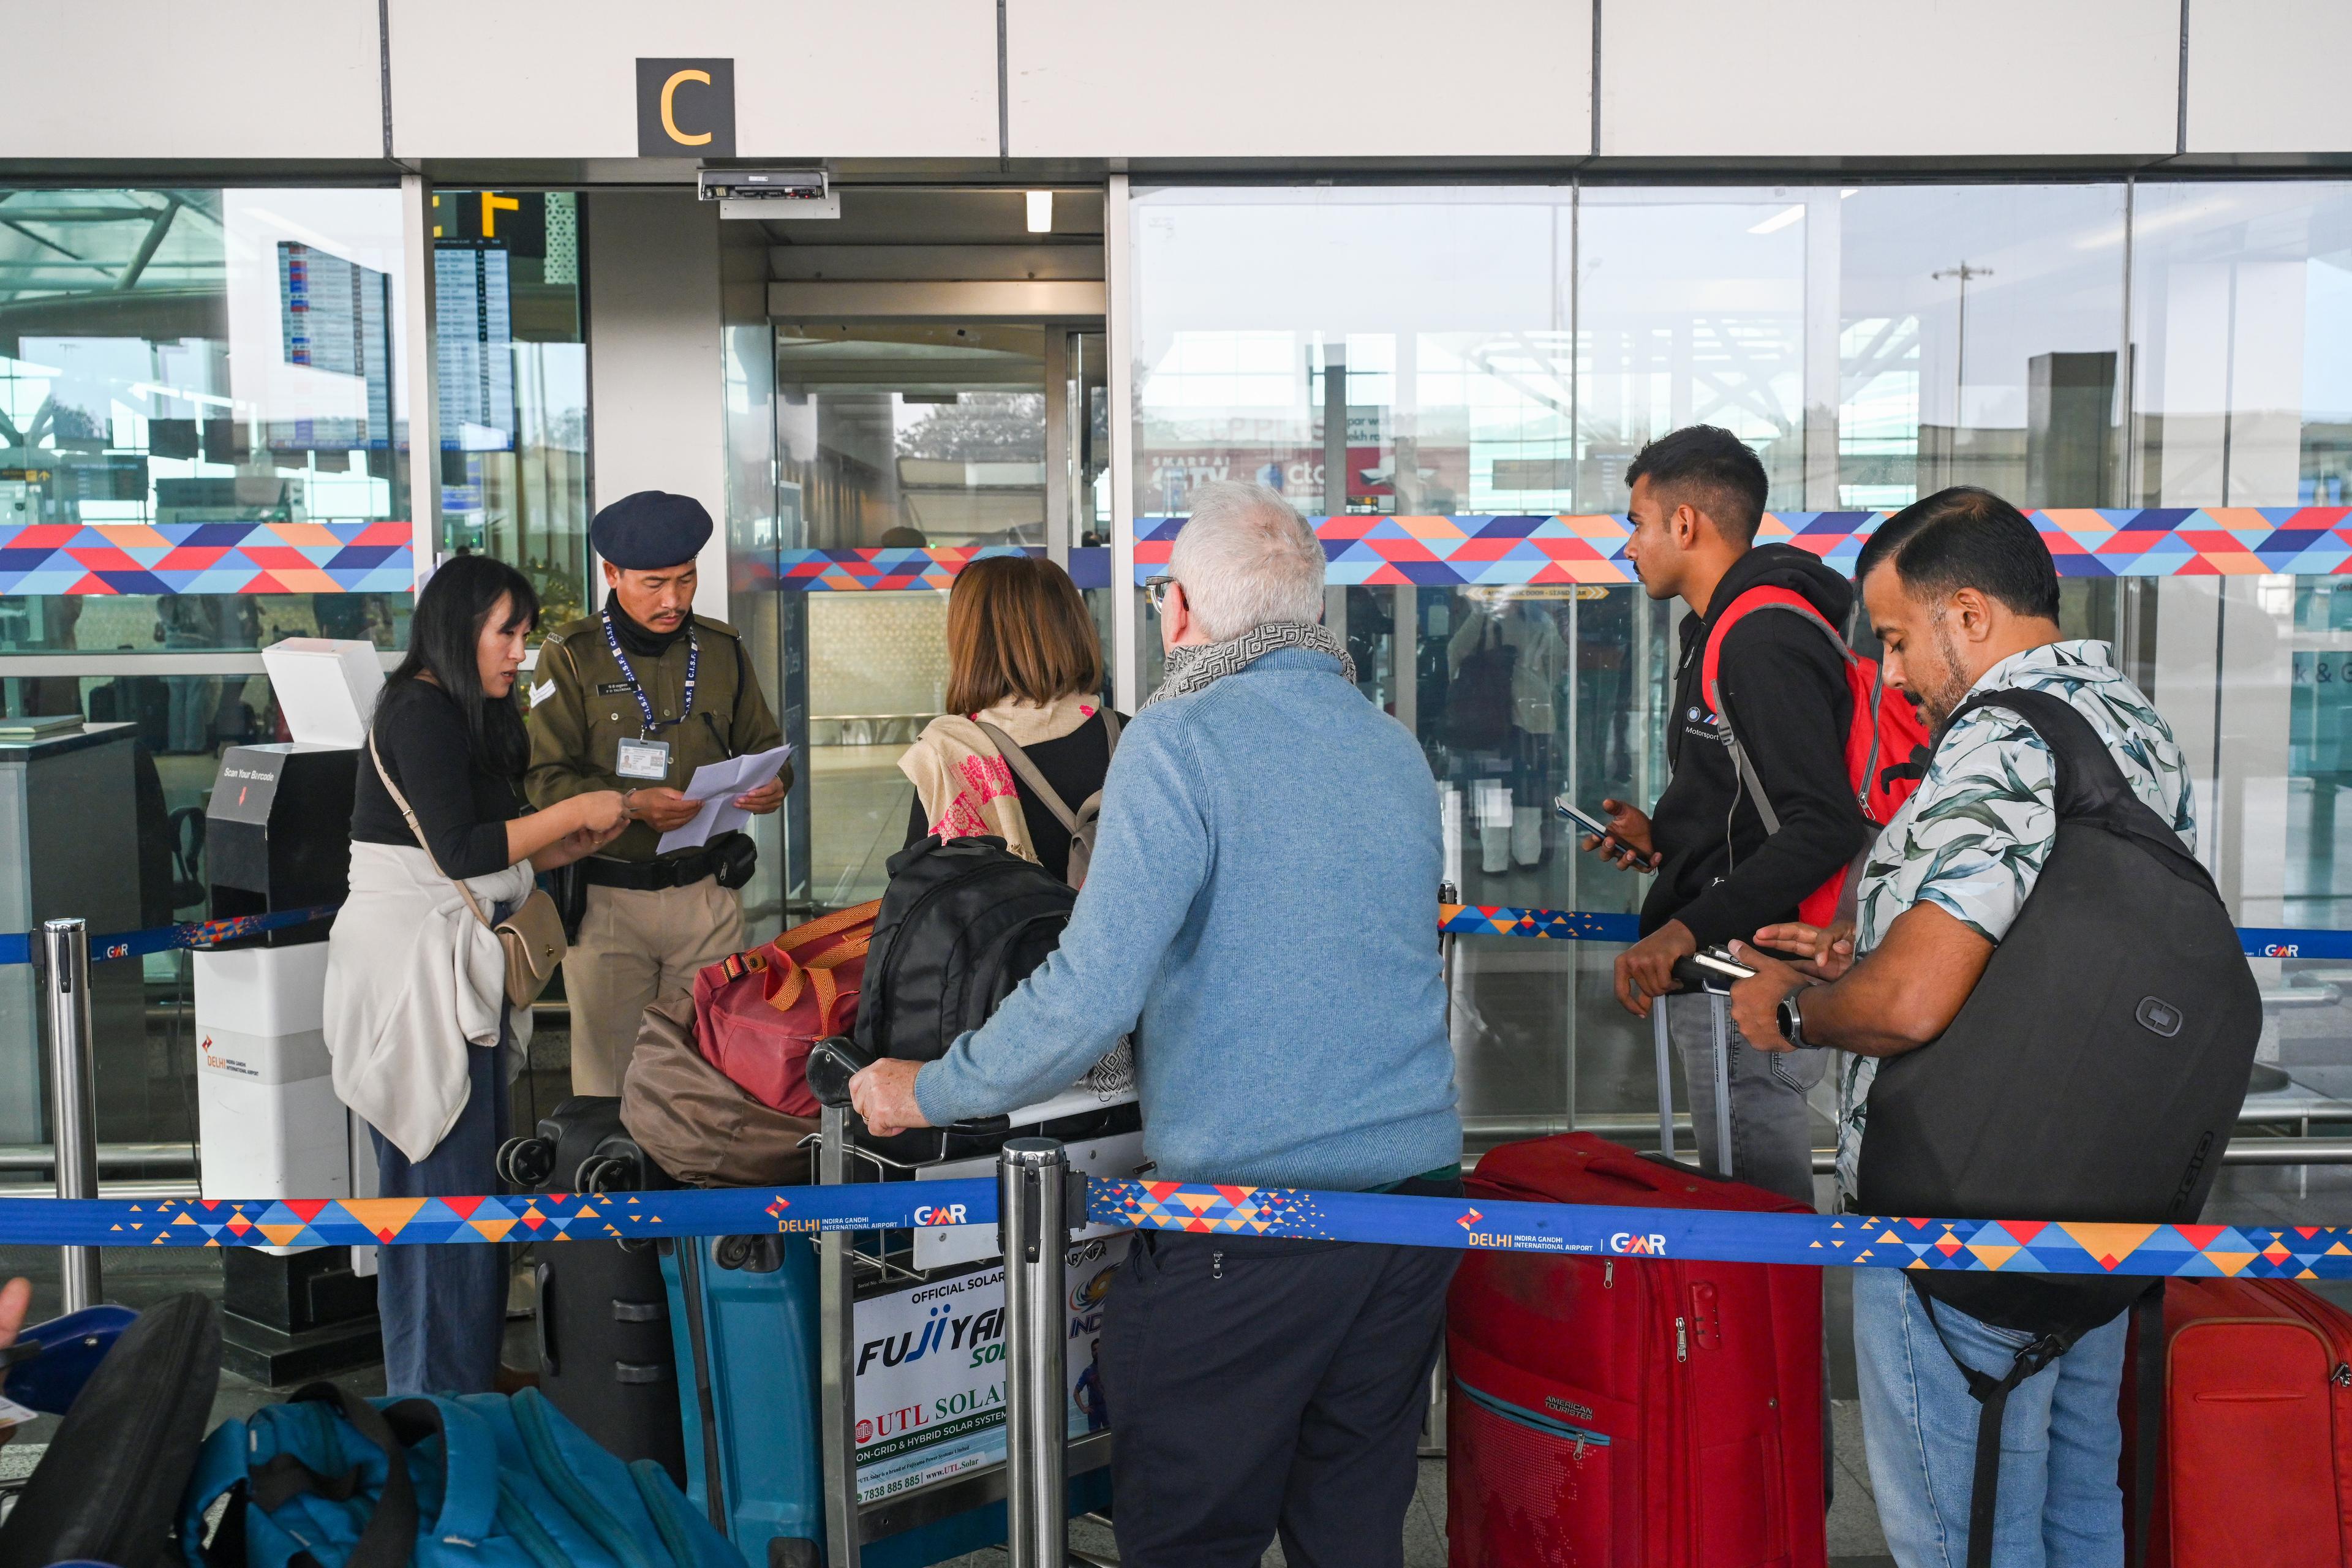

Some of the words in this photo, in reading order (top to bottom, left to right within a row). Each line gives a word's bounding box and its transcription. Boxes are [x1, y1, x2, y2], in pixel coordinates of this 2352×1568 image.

[660, 69, 712, 146] C
[1152, 456, 1206, 467] SMART
[1685, 726, 1719, 741] Motorsport
[224, 767, 238, 777] Scan
[238, 769, 251, 779] Your
[207, 1055, 226, 1069] DELHI
[2166, 1131, 2214, 1218] OGIO
[778, 1219, 820, 1232] DELHI
[913, 1204, 967, 1226] GMR
[1468, 1232, 1512, 1248] DELHI
[1514, 1242, 1564, 1251] INTERNATIONAL
[1610, 1232, 1666, 1255] GMR
[911, 1282, 965, 1304] OFFICIAL
[967, 1271, 1005, 1291] SOLAR
[1545, 1396, 1593, 1415] AMERICAN
[1545, 1401, 1593, 1421] TOURISTER
[876, 1404, 929, 1436] UTL
[856, 1443, 897, 1462] ON-GRID
[907, 1430, 941, 1447] HYBRID
[943, 1420, 973, 1436] SOLAR
[870, 1472, 881, 1481] Solar
[889, 1466, 902, 1475] brand
[938, 1450, 954, 1462] Systems
[864, 1485, 885, 1501] 7838
[887, 1480, 903, 1493] 885
[905, 1474, 920, 1488] 885
[925, 1458, 979, 1480] www.UTL.Solar
